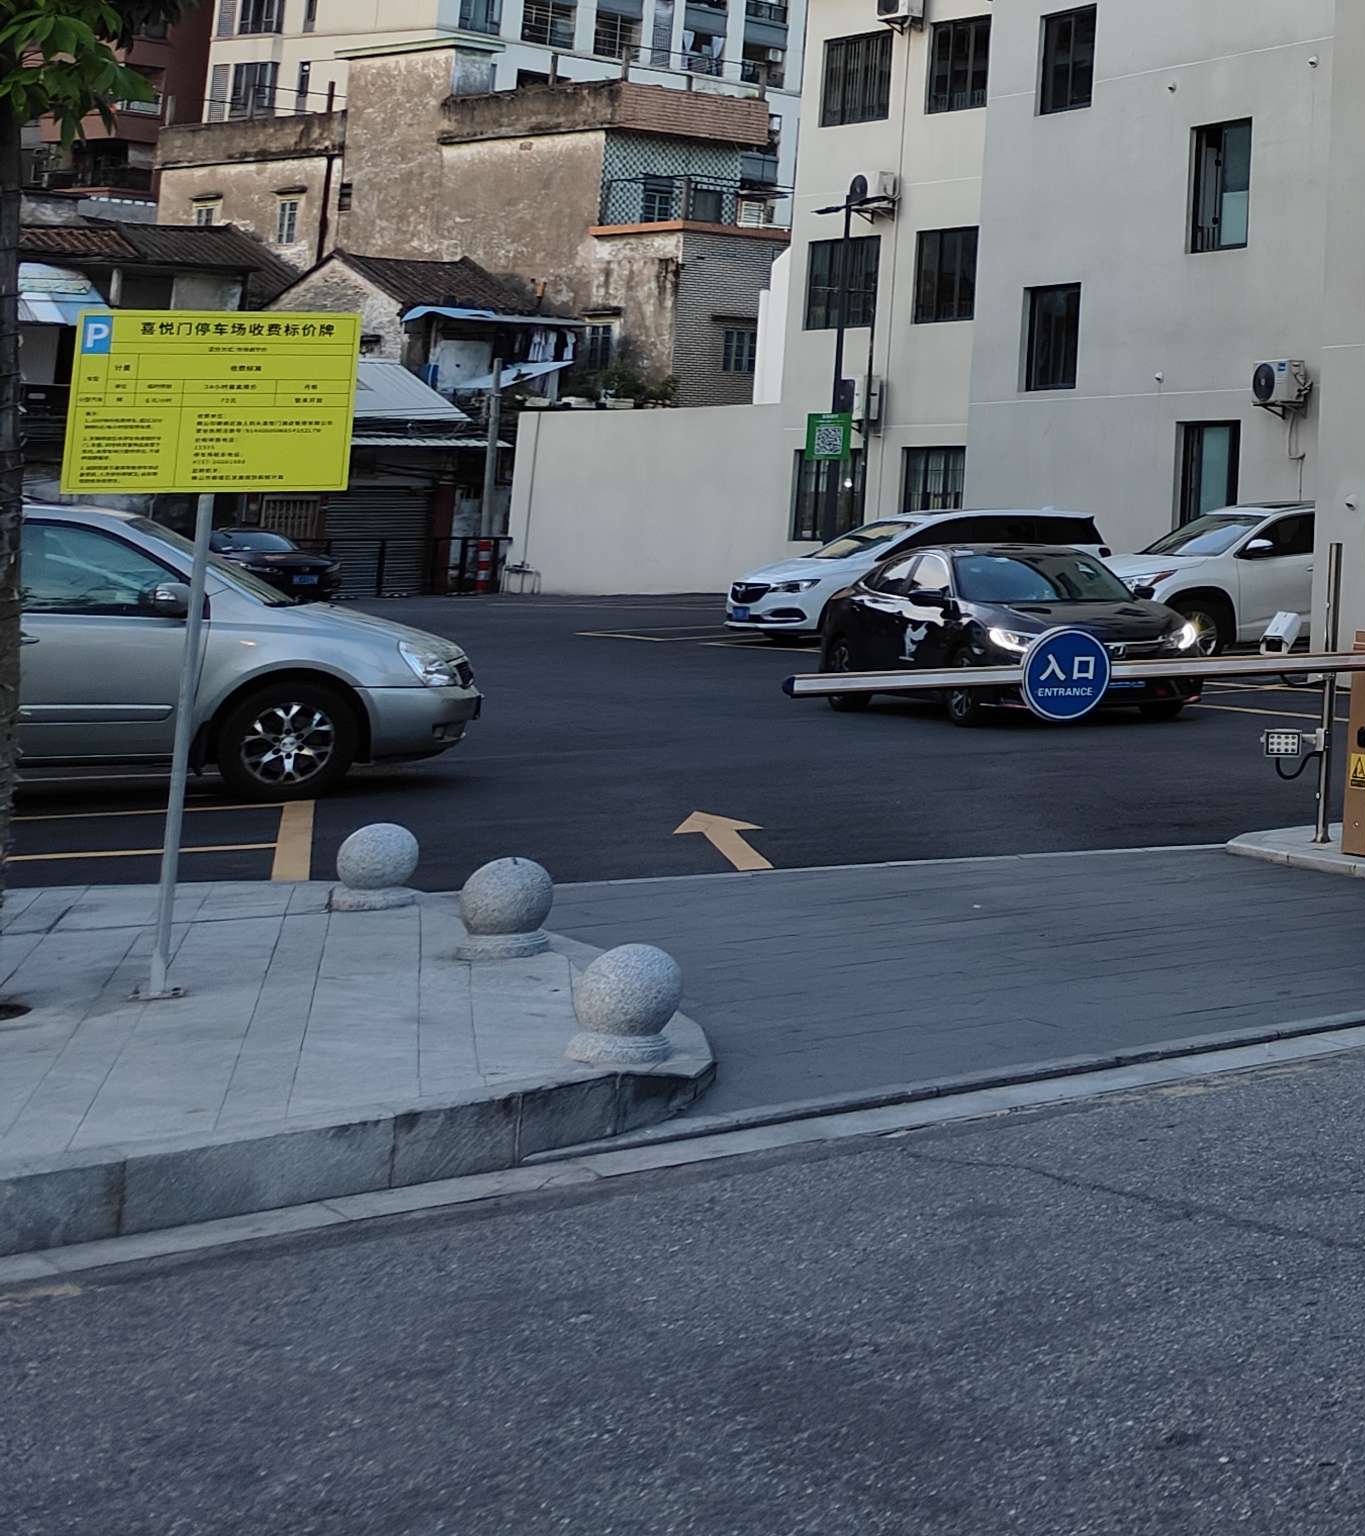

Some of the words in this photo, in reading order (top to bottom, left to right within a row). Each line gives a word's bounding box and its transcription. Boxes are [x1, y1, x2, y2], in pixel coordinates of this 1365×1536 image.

[86, 323, 109, 348] P
[141, 321, 335, 337] 喜悦门停车场收费标价牌
[1039, 653, 1096, 681] 入口
[1038, 687, 1093, 697] ENTRANCE
